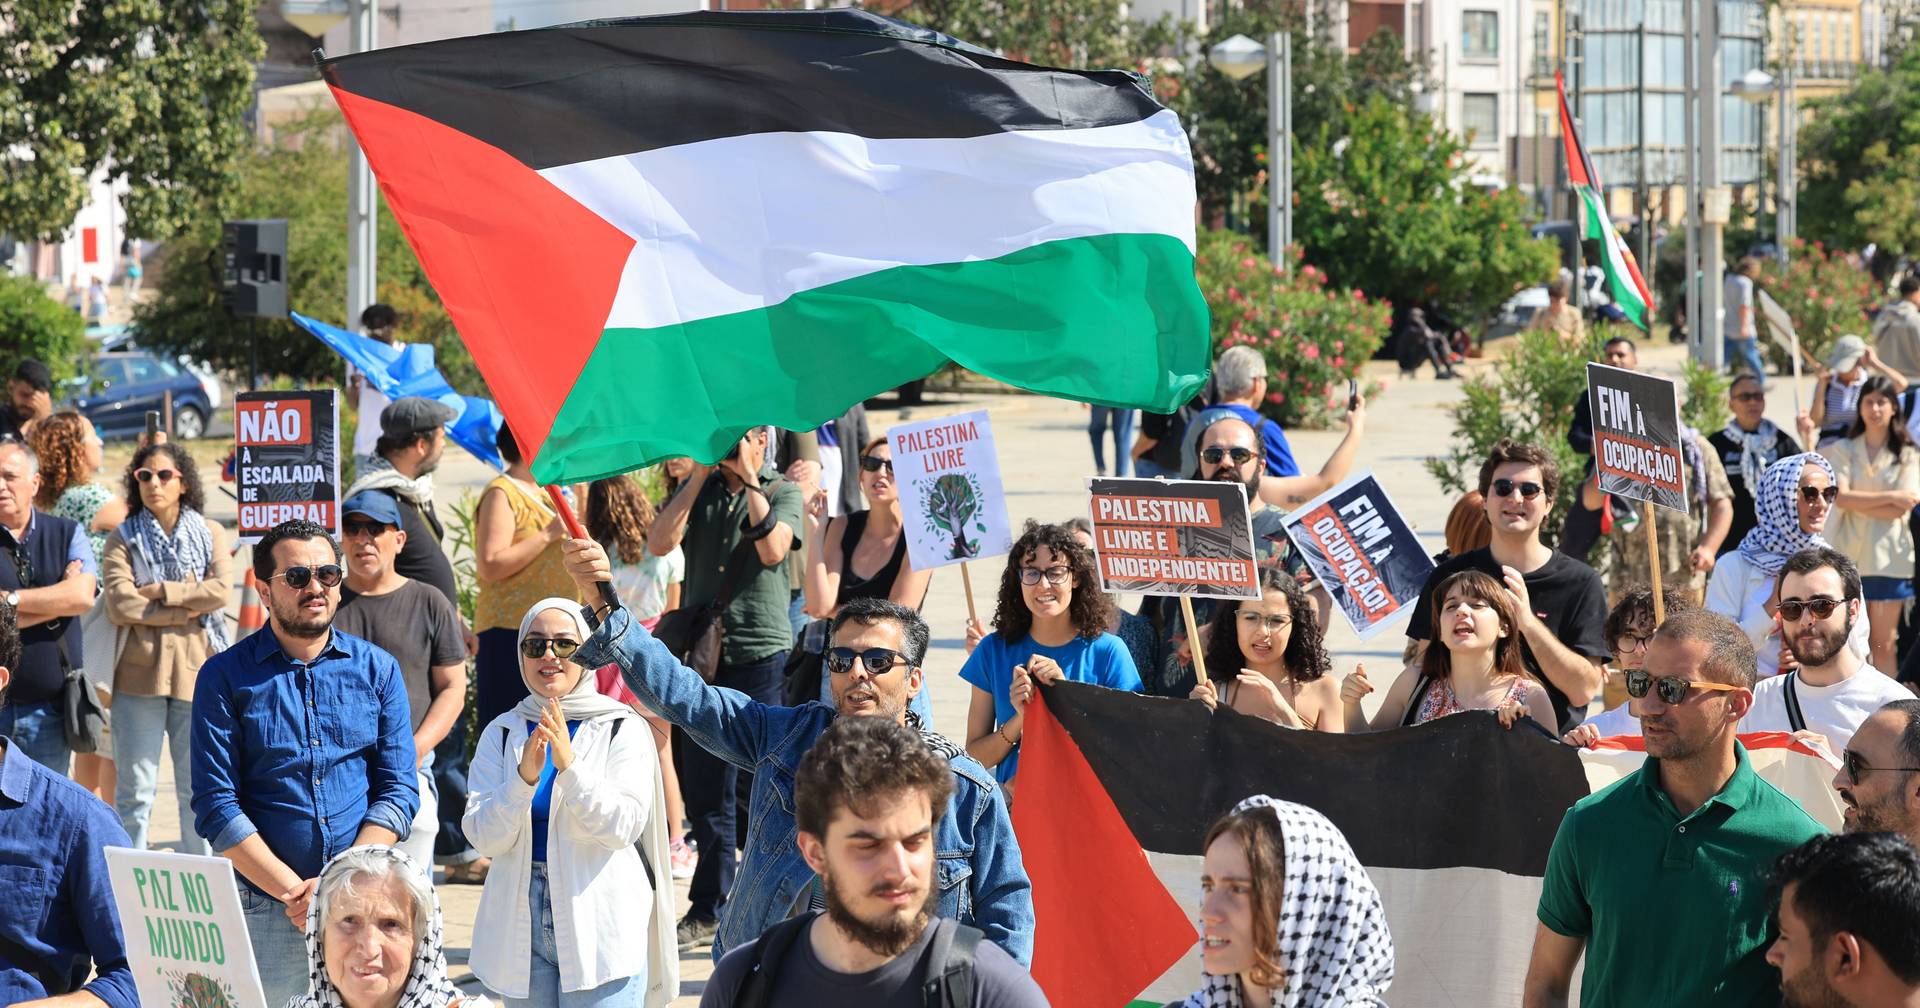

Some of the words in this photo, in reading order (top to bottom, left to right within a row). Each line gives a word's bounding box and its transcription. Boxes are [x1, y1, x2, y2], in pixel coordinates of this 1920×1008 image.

[240, 401, 301, 443] NÃO
[1597, 385, 1633, 433] FIM
[1635, 403, 1647, 436] À
[896, 420, 979, 454] PALESTINA
[242, 446, 252, 464] À
[923, 447, 966, 473] LIVRE
[1602, 438, 1678, 484] OCUPAÇÃO!
[242, 464, 326, 485] ESCALADA
[242, 488, 258, 502] DE
[241, 503, 327, 528] GUERRA!
[1098, 498, 1210, 524] PALESTINA
[1102, 529, 1155, 550] LIVRE
[1157, 530, 1169, 551] E
[1338, 494, 1392, 550] FIM
[1370, 544, 1394, 565] À
[1107, 557, 1248, 582] INDEPENDENTE!
[1312, 516, 1390, 613] OCUPAÇÃO!
[132, 867, 179, 911] PAZ
[179, 871, 214, 915] NO
[144, 915, 225, 965] MUNDO
